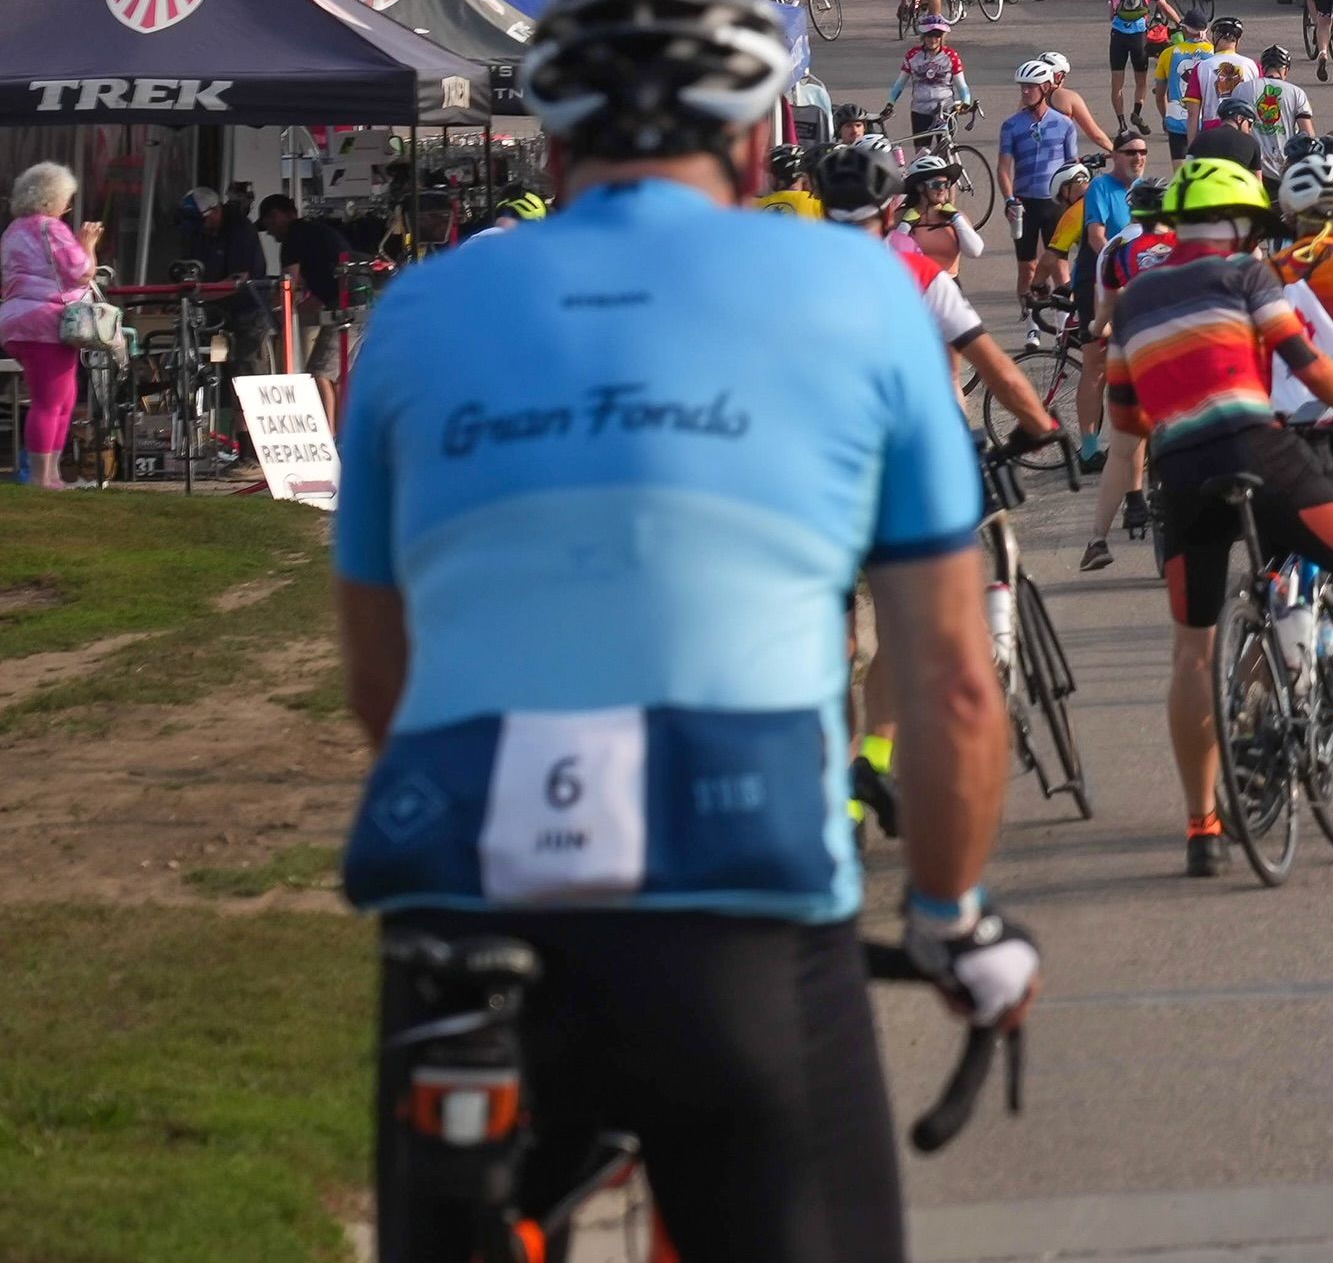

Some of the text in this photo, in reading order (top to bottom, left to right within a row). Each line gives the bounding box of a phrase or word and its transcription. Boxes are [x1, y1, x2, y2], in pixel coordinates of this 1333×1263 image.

[28, 78, 235, 112] TREK
[258, 385, 297, 405] NOW
[256, 414, 318, 435] TAKING
[440, 383, 749, 460] Gran Fondo
[260, 442, 333, 464] REPAIRS
[543, 754, 584, 810] 6
